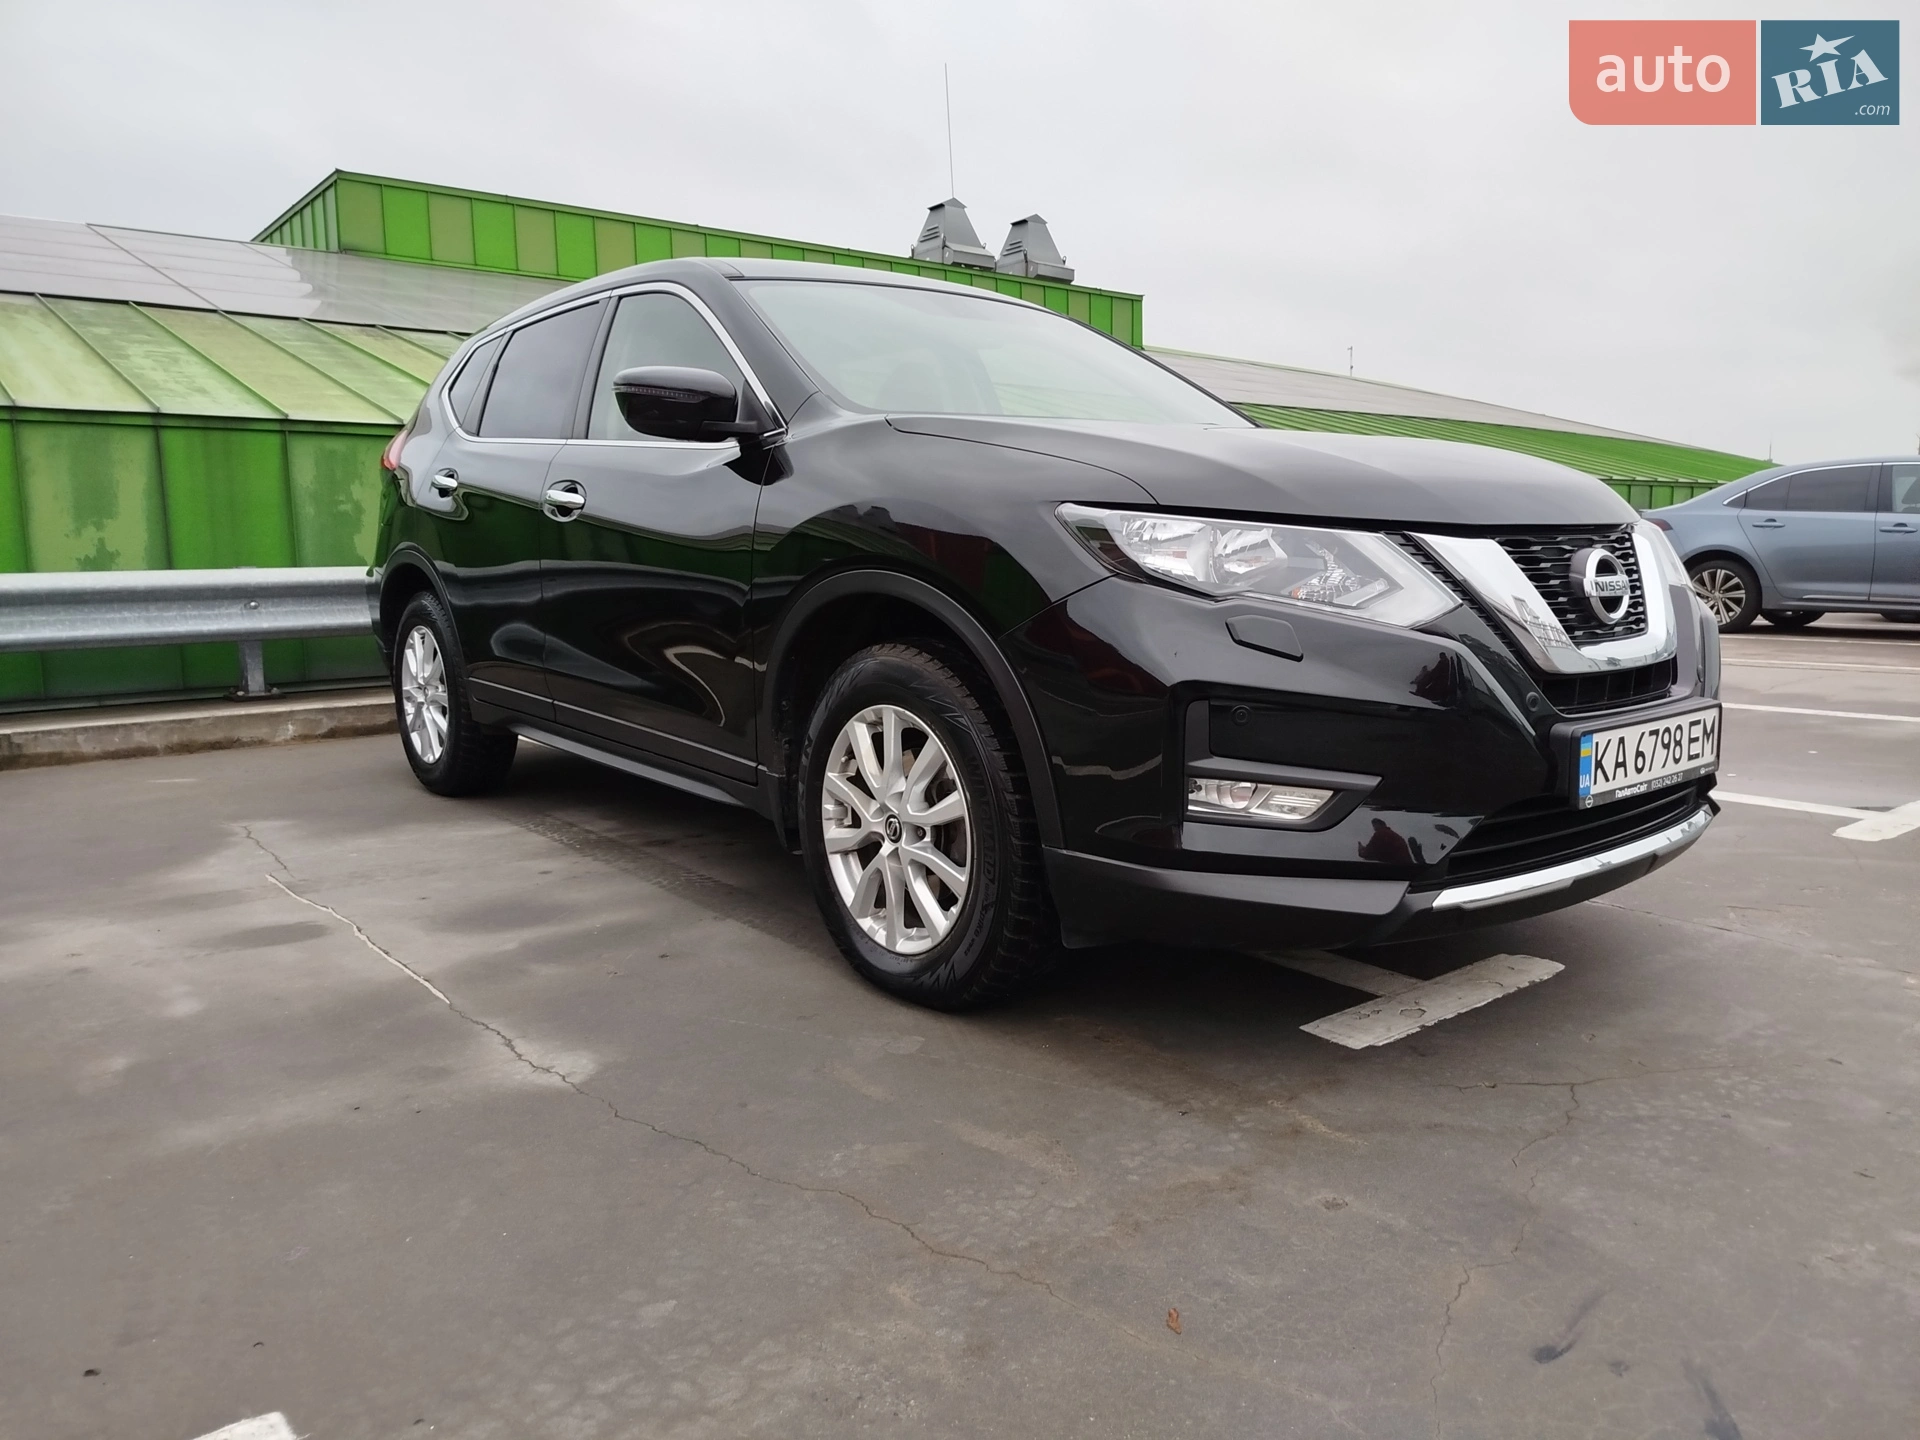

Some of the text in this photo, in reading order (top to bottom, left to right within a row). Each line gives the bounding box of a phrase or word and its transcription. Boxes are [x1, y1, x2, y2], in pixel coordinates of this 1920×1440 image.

[1594, 715, 1716, 786] KA 6798 EM
[1580, 774, 1590, 788] UA
